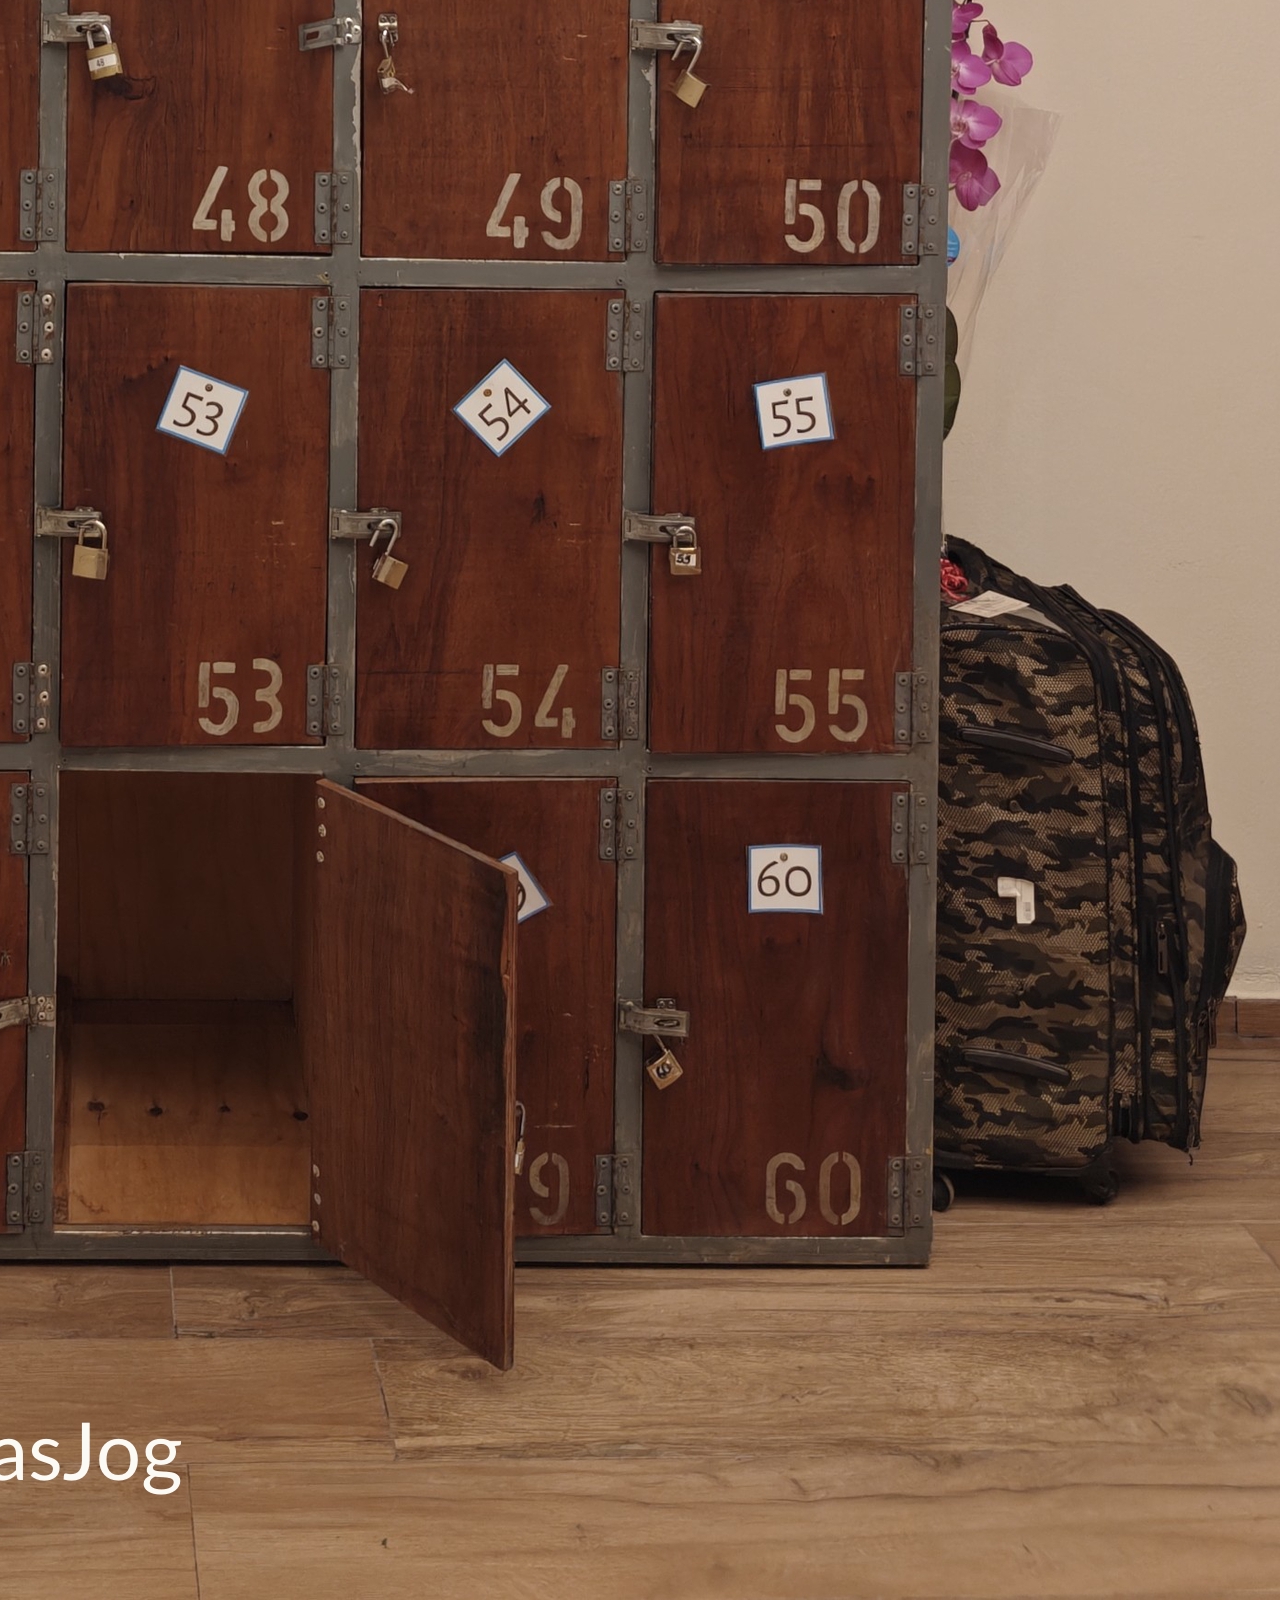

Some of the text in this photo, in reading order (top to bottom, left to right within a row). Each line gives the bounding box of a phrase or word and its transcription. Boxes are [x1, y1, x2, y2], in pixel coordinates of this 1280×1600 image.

[193, 166, 289, 242] 48
[486, 173, 583, 249] 49
[785, 179, 880, 253] 50
[173, 392, 223, 436] 53
[478, 387, 530, 441] 54
[772, 396, 816, 437] 55
[199, 658, 282, 735] 53
[482, 664, 575, 738] 54
[775, 668, 867, 743] 55
[758, 860, 811, 897] 60
[529, 1152, 569, 1225] 9
[766, 1152, 861, 1225] 60
